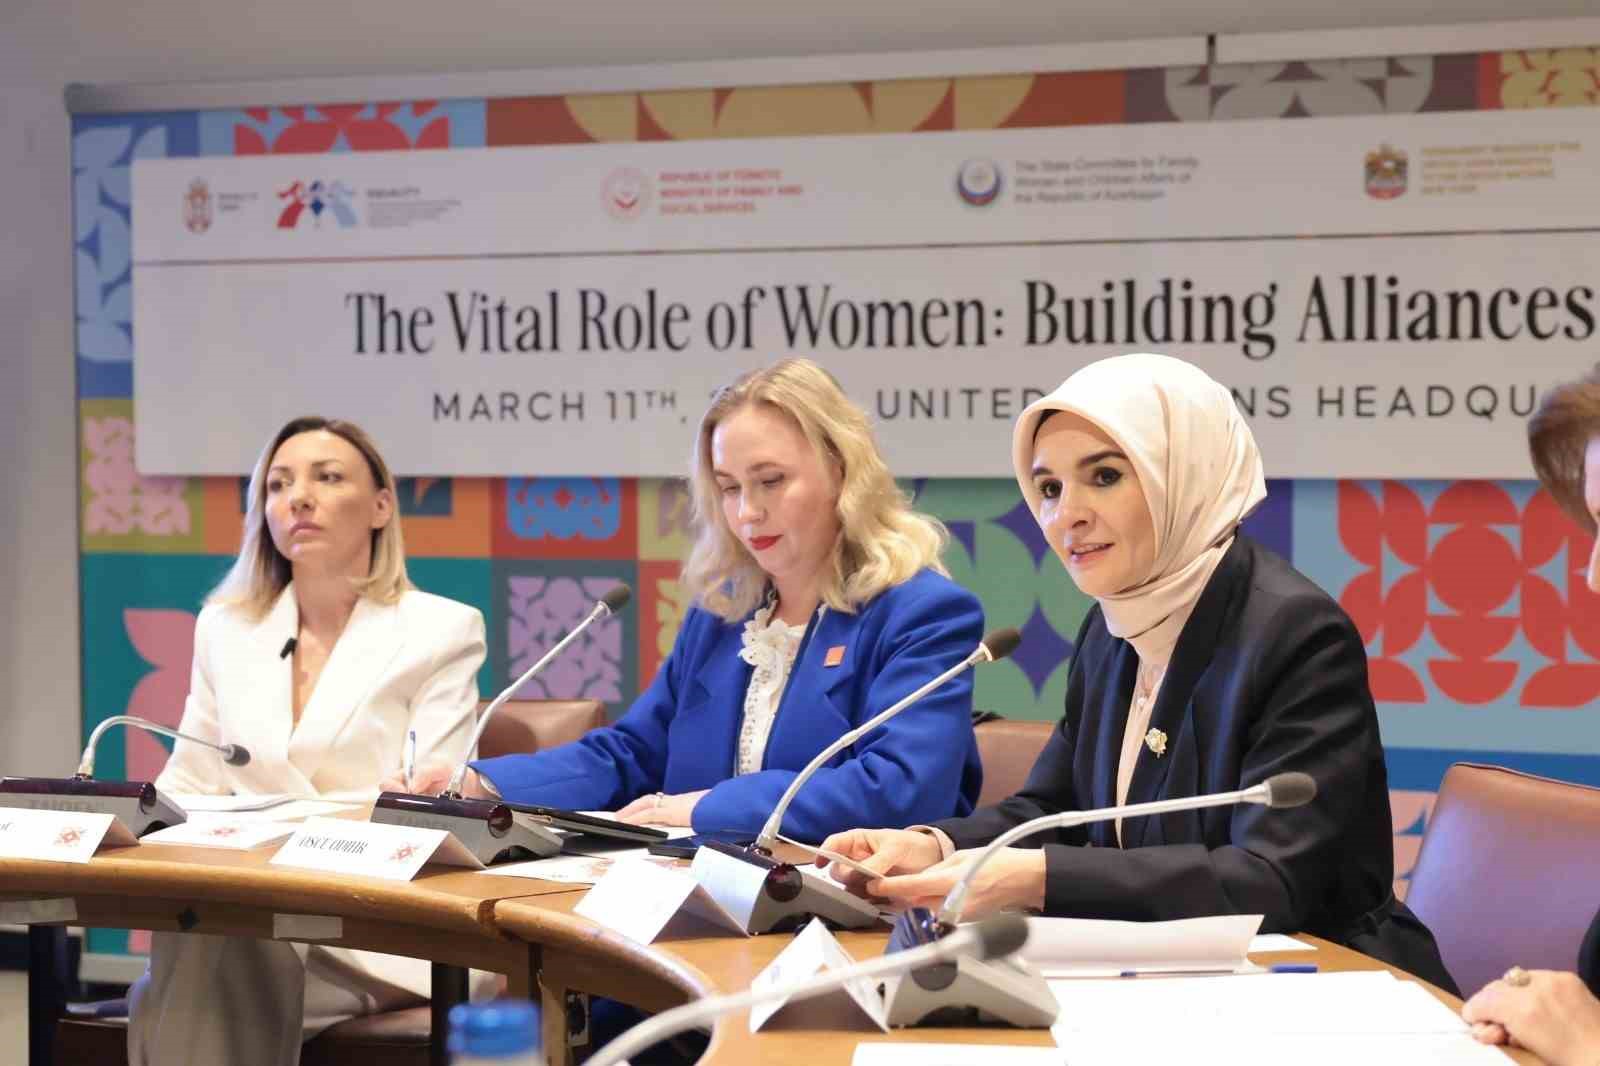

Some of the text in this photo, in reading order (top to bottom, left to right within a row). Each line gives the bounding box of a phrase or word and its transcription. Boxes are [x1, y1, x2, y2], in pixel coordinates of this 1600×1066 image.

[346, 273, 1595, 361] The Vital Role of Women: Building Alliances
[433, 391, 585, 422] MARCH
[1317, 384, 1536, 421] HEADQU
